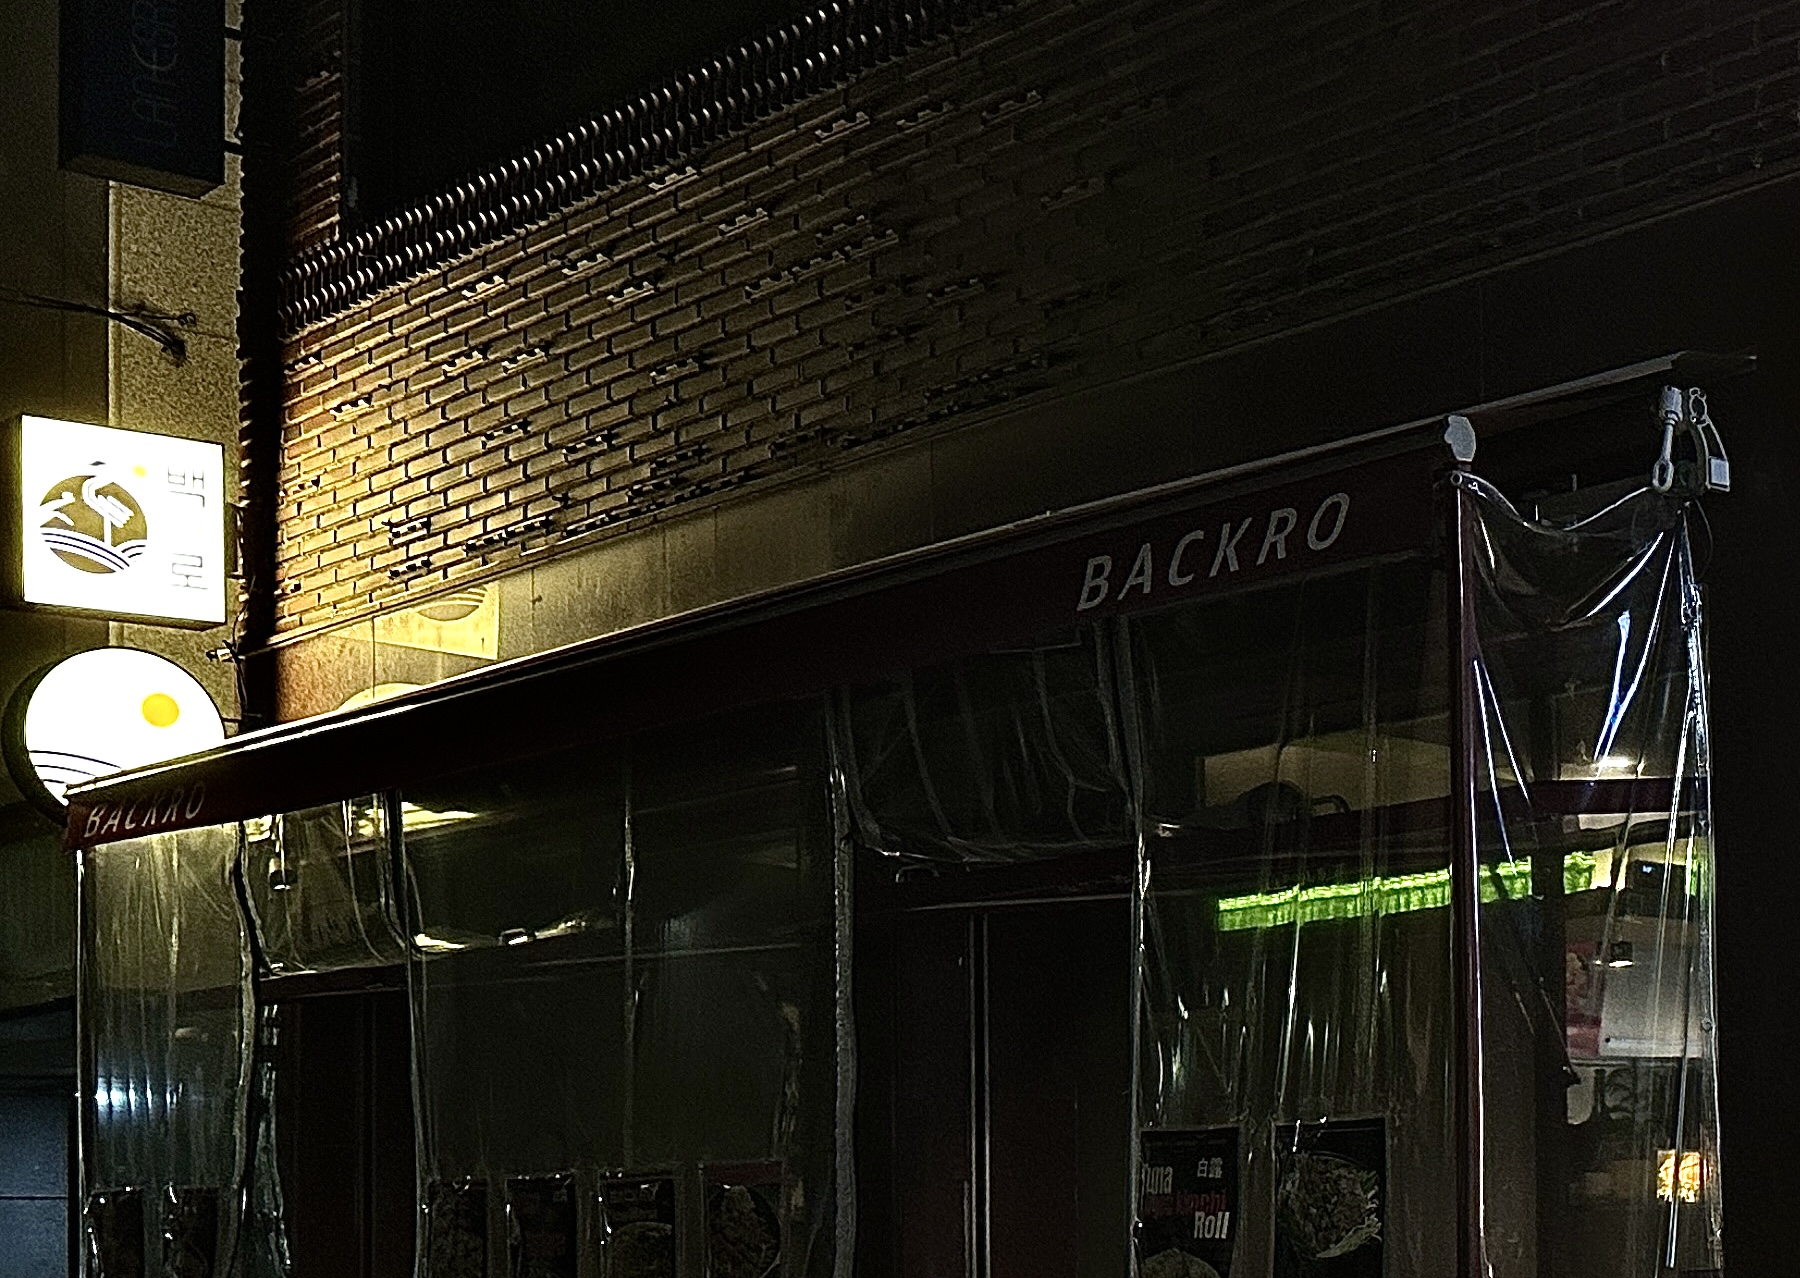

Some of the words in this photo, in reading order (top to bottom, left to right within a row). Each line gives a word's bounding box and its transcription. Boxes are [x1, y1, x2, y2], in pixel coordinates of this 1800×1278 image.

[166, 464, 209, 591] 백로
[1074, 491, 1353, 614] BACKRO
[82, 781, 207, 839] BACKRO
[1193, 1211, 1231, 1240] Roll
